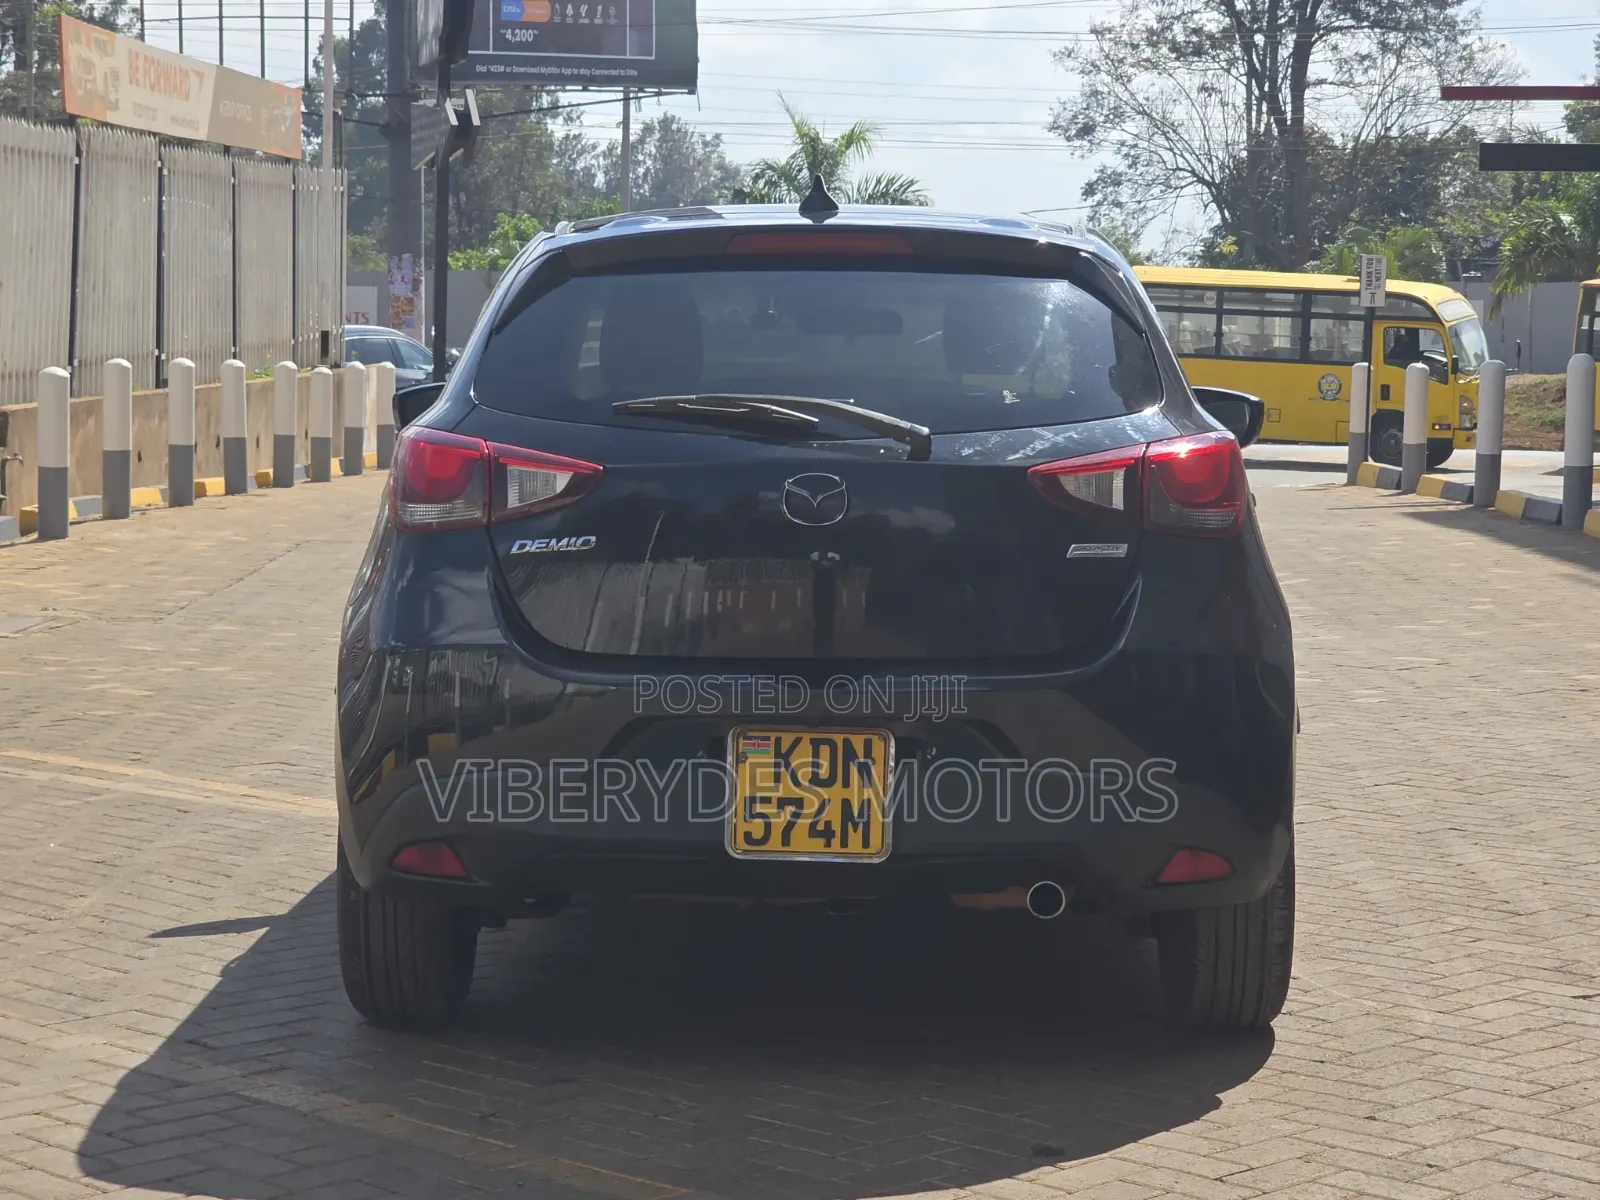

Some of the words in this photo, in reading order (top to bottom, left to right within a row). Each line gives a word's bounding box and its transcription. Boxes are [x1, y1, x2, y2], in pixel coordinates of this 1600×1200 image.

[505, 28, 534, 43] 4,200
[128, 49, 140, 87] BE
[143, 54, 190, 102] FORWARD
[475, 64, 487, 73] Dial
[512, 65, 540, 74] Download
[561, 67, 572, 76] App
[572, 67, 579, 75] to
[579, 68, 591, 77] stay
[591, 68, 620, 76] Connected
[620, 68, 626, 76] to
[1366, 257, 1374, 269] YOU
[1365, 271, 1373, 290] THANK
[1374, 269, 1382, 282] NEXT
[510, 535, 597, 554] DEMIO
[773, 736, 872, 788] KDN
[743, 796, 871, 849] 574M
